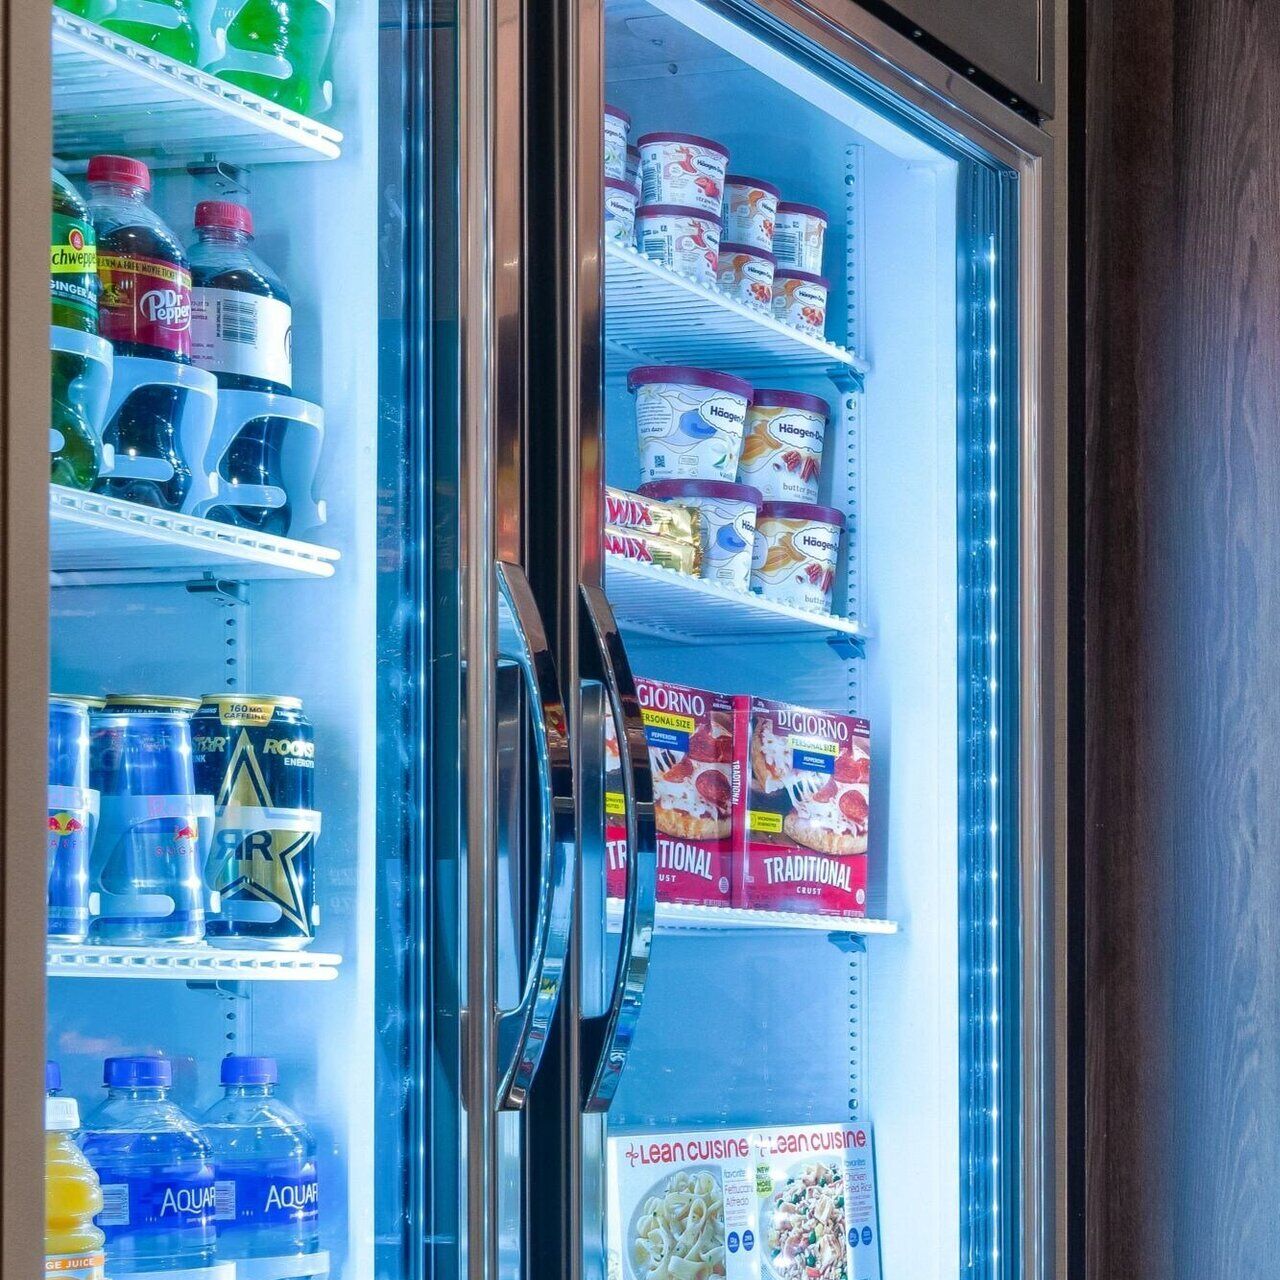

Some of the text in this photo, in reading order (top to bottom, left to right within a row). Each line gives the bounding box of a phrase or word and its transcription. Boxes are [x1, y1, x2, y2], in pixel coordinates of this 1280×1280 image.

[150, 290, 192, 326] Pepper
[675, 718, 692, 730] SIZE
[778, 710, 848, 742] DIGIORNO
[764, 856, 851, 892] TRADITIONAL
[66, 1259, 95, 1269] JUICE
